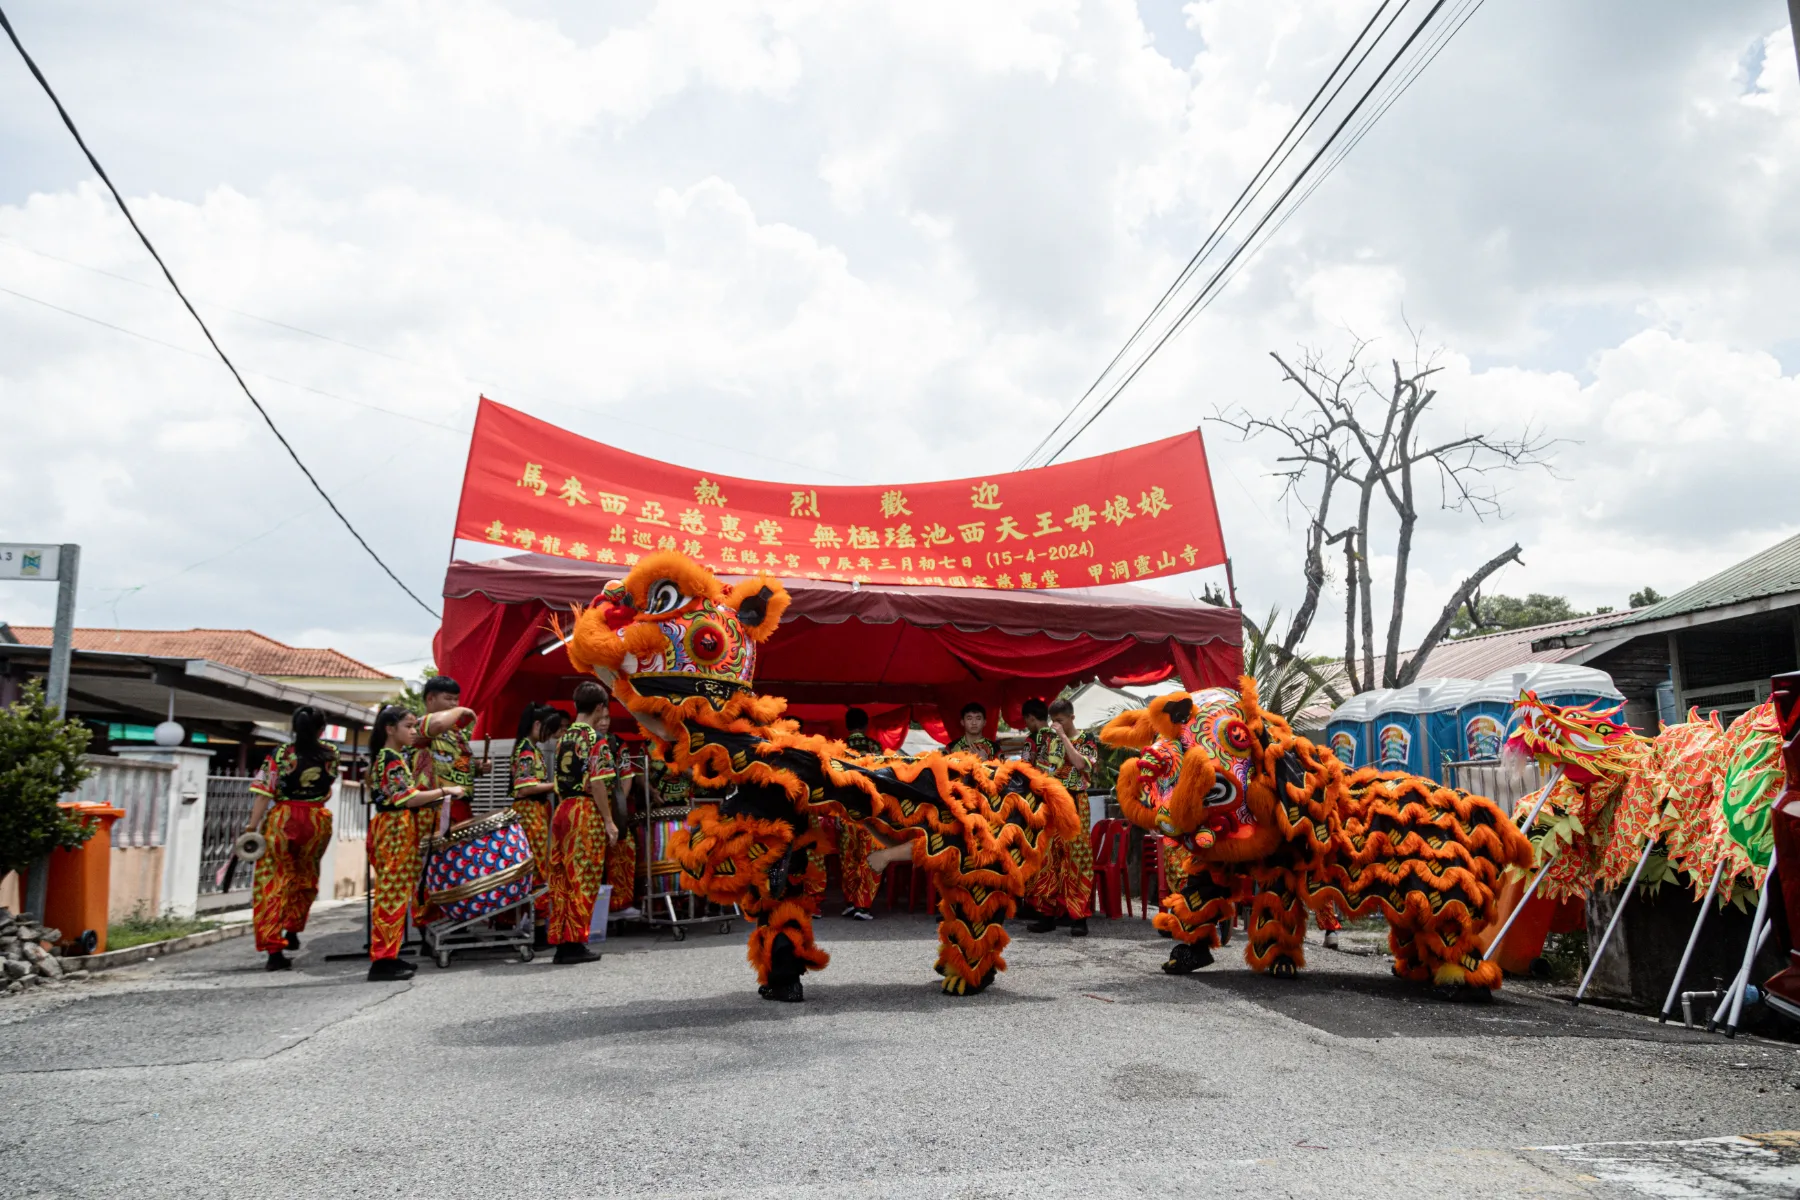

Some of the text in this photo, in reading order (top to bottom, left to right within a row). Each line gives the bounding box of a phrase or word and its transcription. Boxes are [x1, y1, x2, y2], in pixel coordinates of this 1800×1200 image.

[516, 462, 783, 548] 馬來西亞慈惠堂
[5, 552, 13, 561] 3
[816, 555, 973, 572] 甲辰年三月初七日
[986, 539, 1095, 569] (15-4-2024)
[1087, 544, 1200, 584] 甲洞靈山寺
